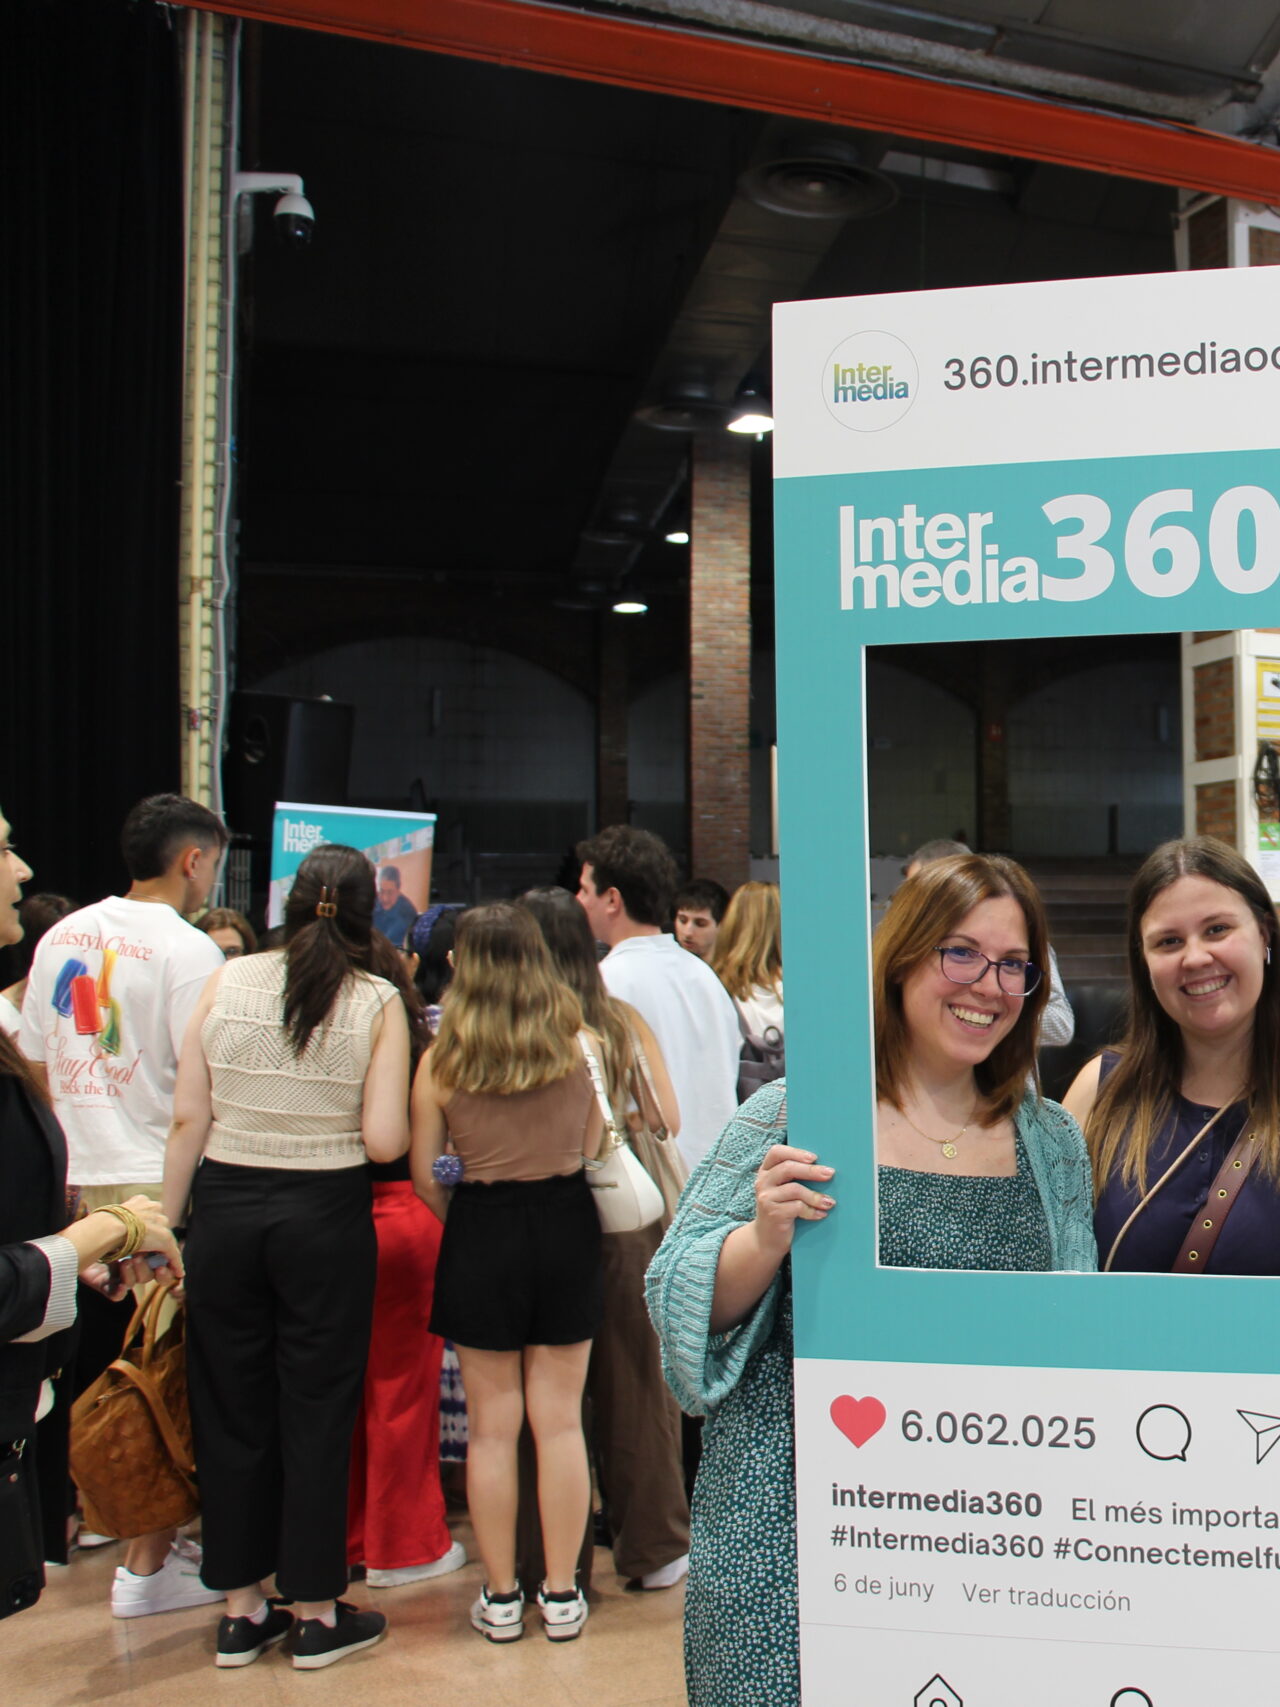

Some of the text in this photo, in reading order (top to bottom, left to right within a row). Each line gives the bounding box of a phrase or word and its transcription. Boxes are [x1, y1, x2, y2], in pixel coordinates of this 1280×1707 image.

[833, 362, 893, 386] Inter
[833, 378, 910, 404] media
[839, 503, 994, 563] Inter
[839, 543, 1041, 611] media
[284, 819, 323, 841] Inter
[105, 936, 153, 961] Choice
[84, 1081, 104, 1096] the
[901, 1409, 1096, 1450] 6.062.025
[831, 1482, 1043, 1518] intermedia360
[1071, 1497, 1097, 1522] El
[1104, 1500, 1163, 1525] més
[830, 1524, 1044, 1559] #Intermedia360
[834, 1572, 1131, 1612] 6 de juny Ver traducción
